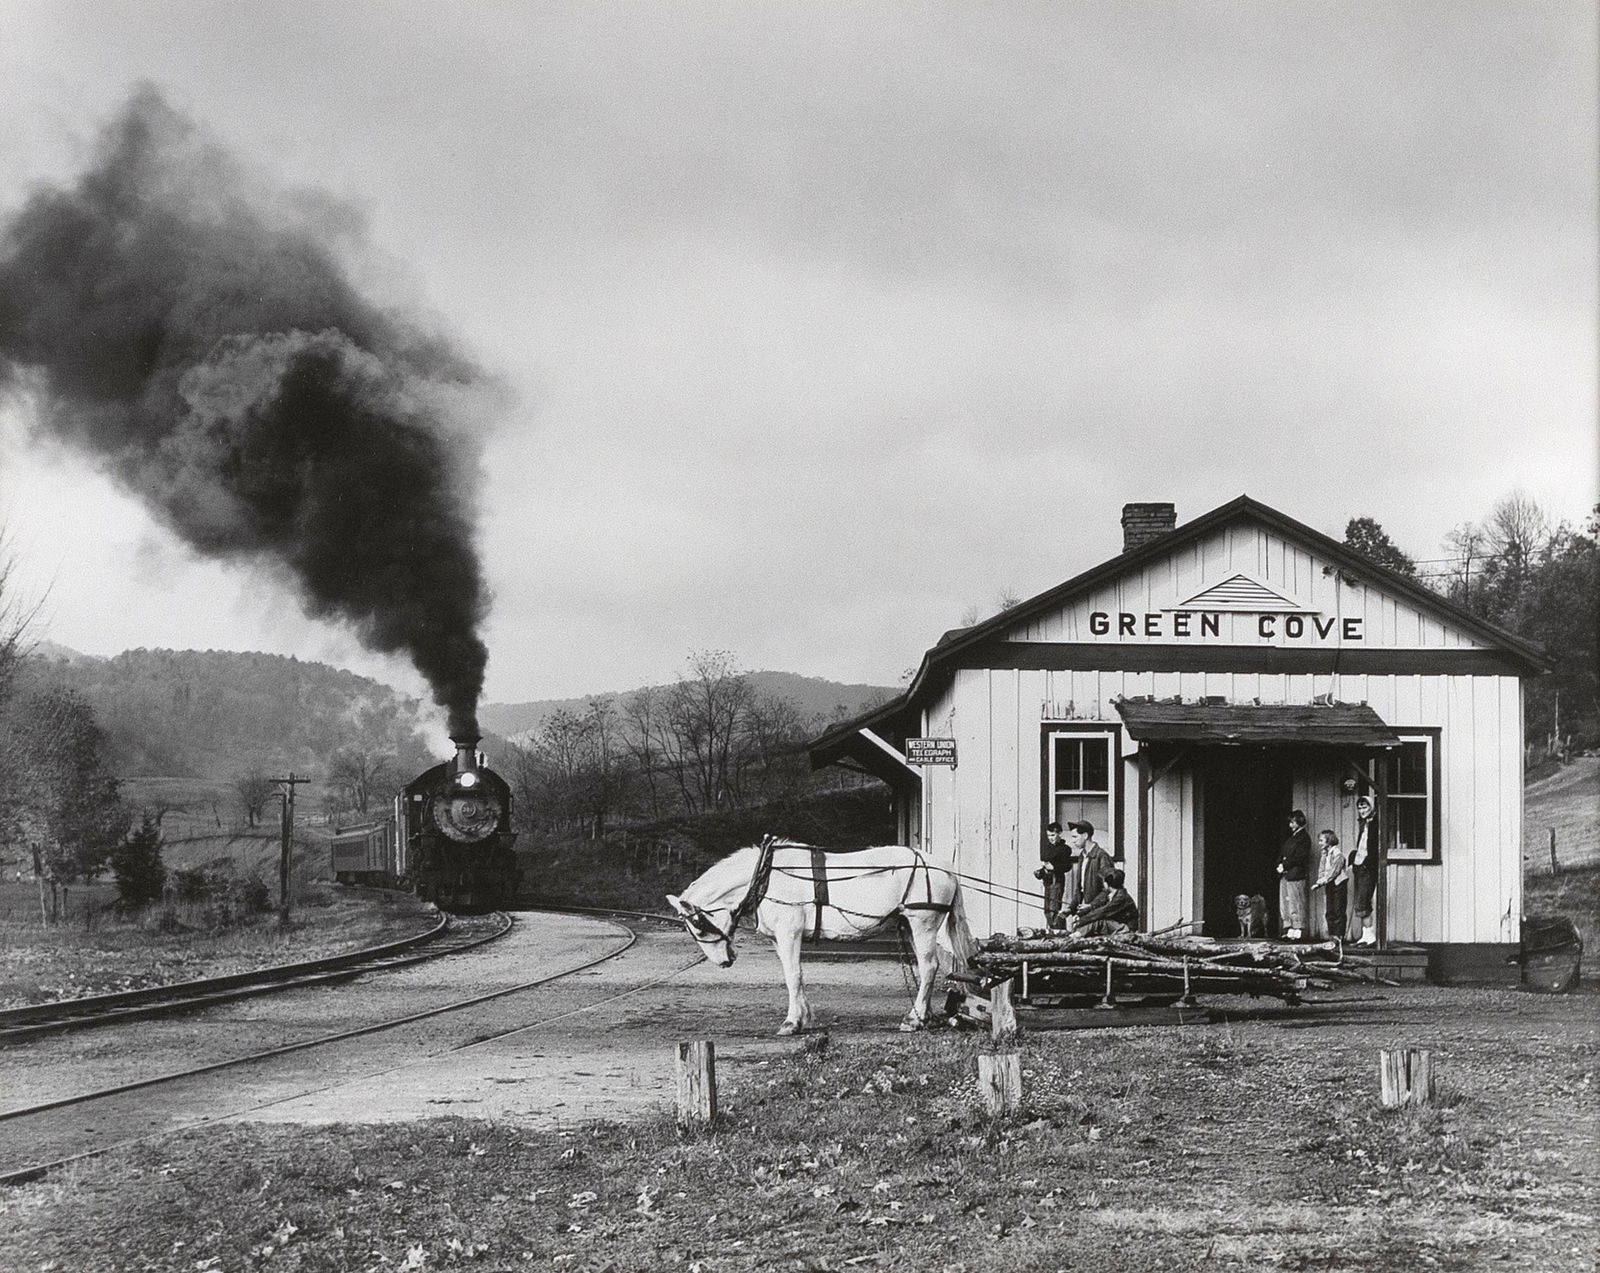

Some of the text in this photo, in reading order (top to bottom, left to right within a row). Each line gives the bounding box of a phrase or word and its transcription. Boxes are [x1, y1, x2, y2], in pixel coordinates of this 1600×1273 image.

[1089, 611, 1363, 640] GREEN COVE
[908, 740, 955, 749] WESTERN UNION
[911, 749, 952, 757] TELEGRAPH
